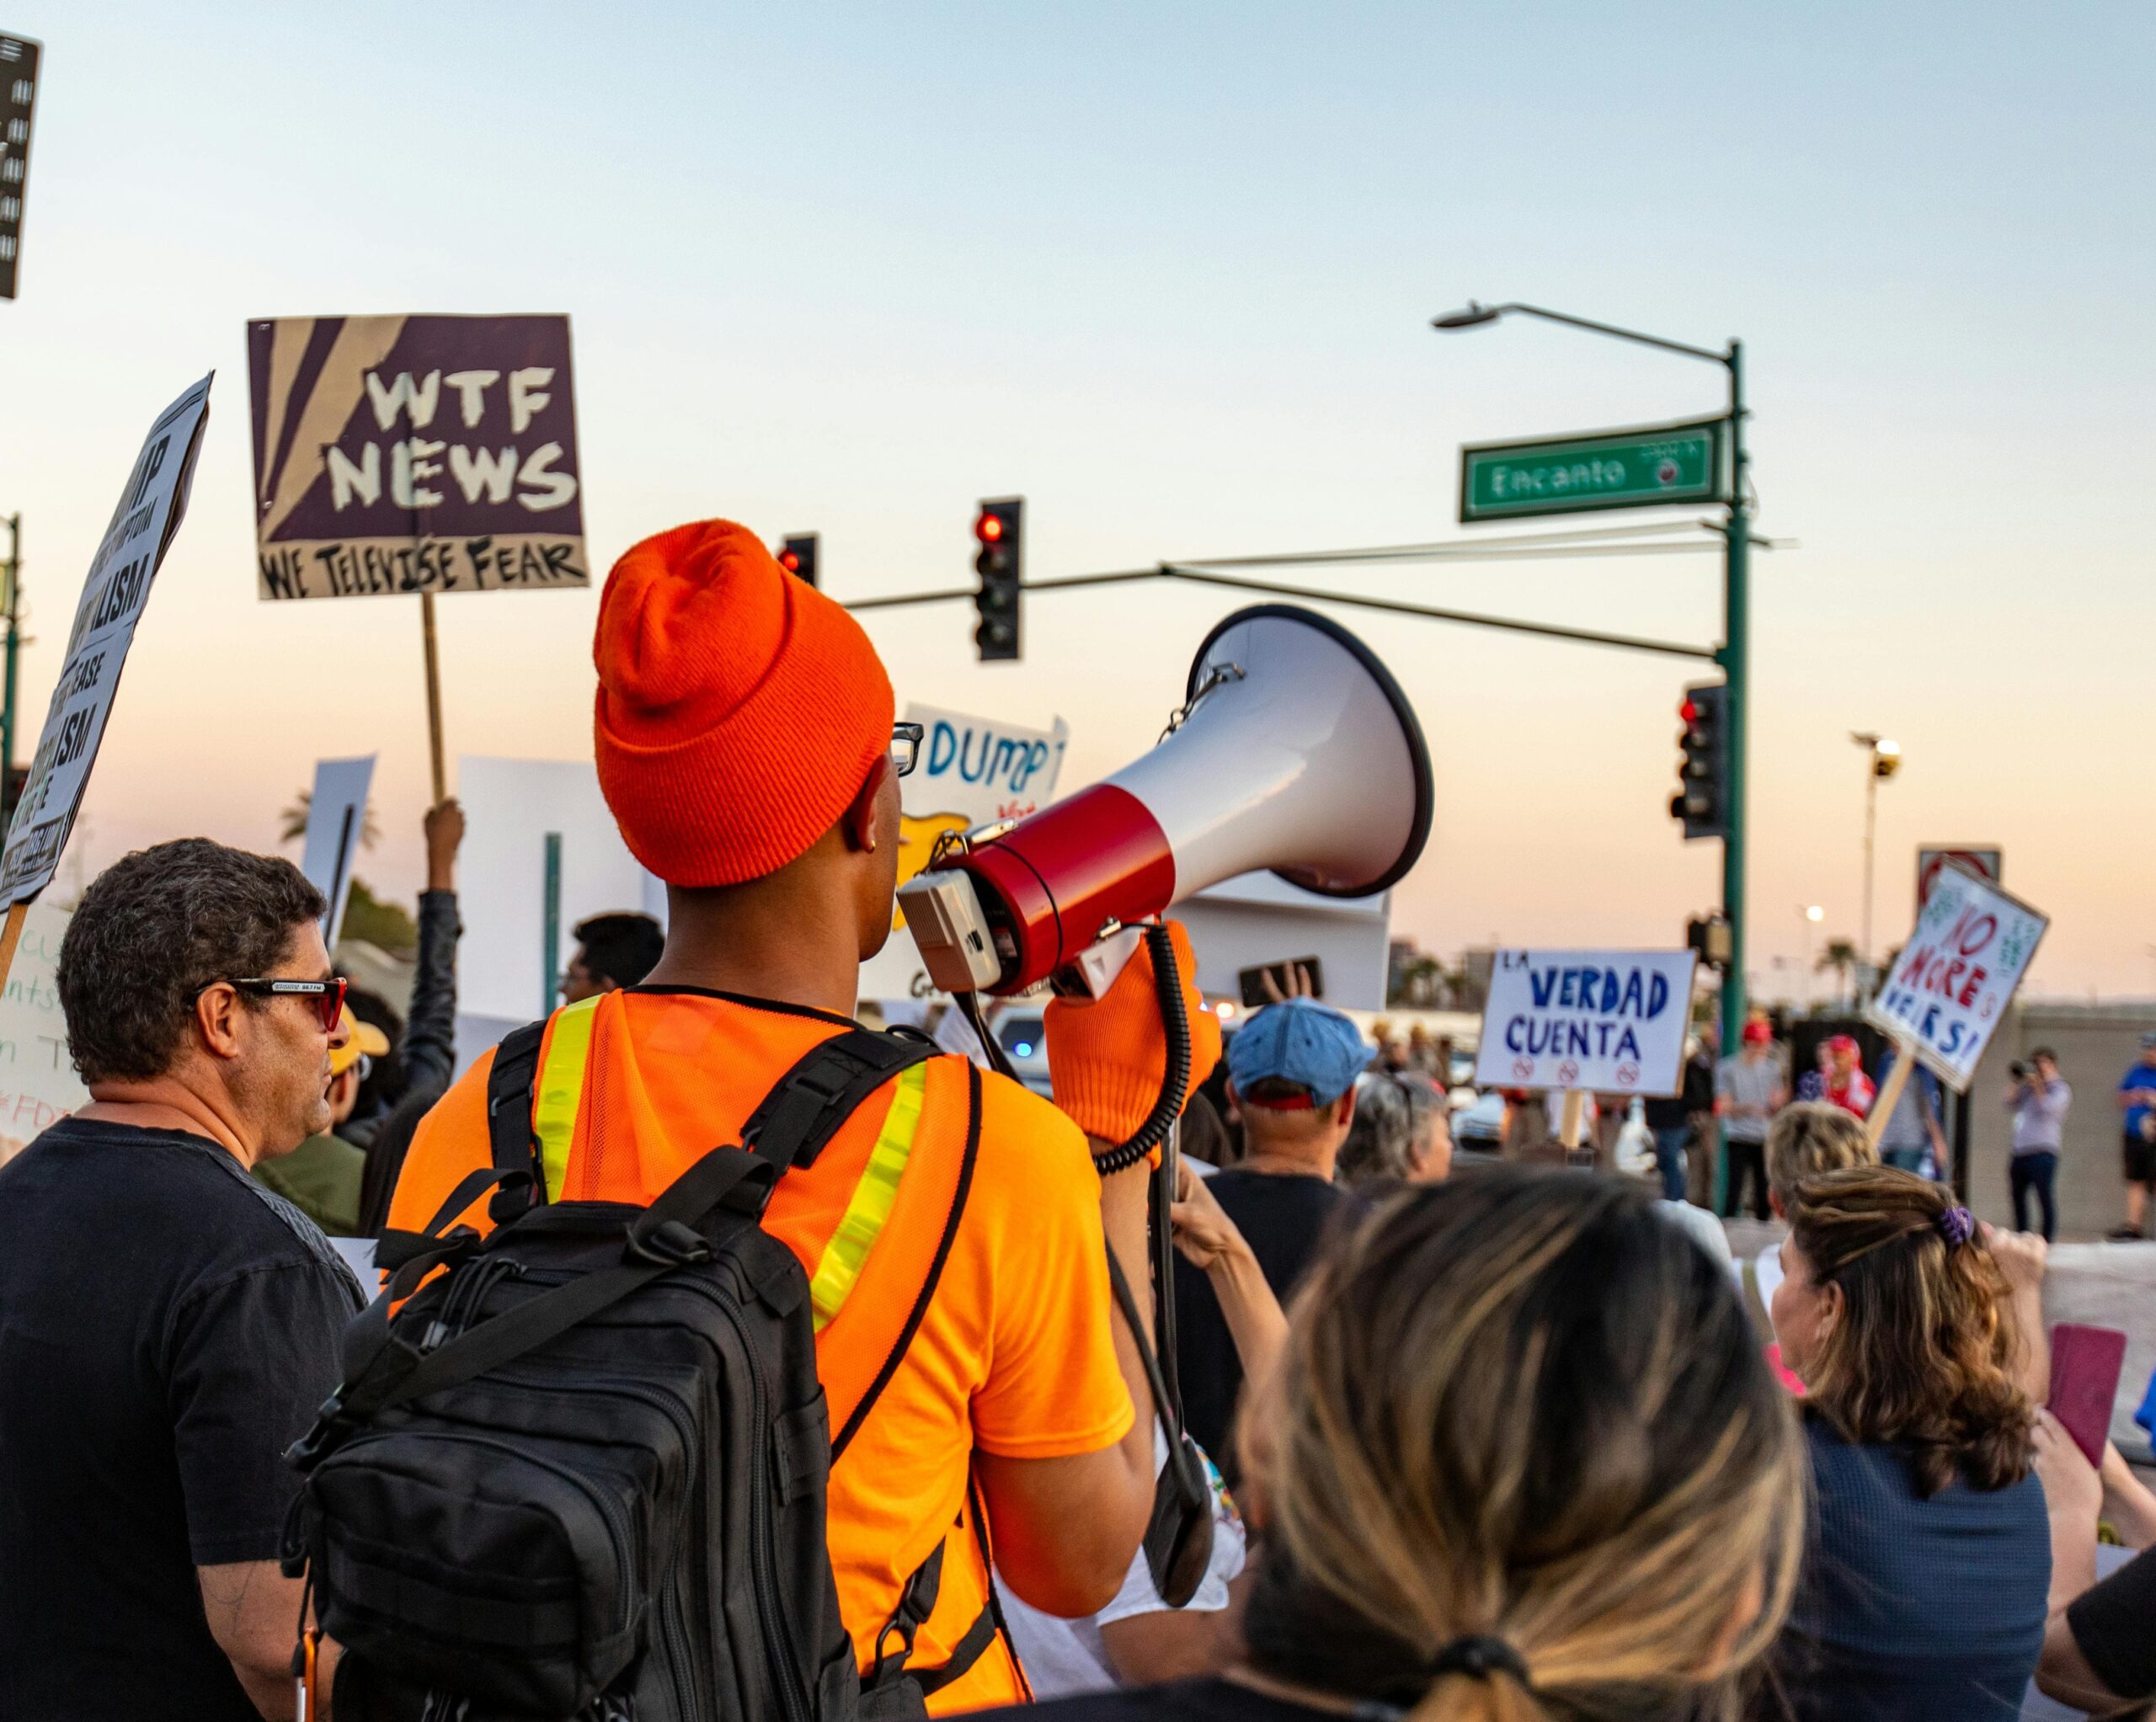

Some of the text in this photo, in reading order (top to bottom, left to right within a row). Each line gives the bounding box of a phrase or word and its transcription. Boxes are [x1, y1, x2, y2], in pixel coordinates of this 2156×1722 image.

[366, 366, 556, 434] WTF
[327, 436, 578, 512] NEWS
[1491, 457, 1626, 498] Encanto
[259, 536, 588, 599] WE TELEVISE FEAR
[1940, 902, 1998, 957] NO
[1502, 951, 1669, 1020] LA VERDAD
[1899, 945, 1988, 1009] MORE
[1505, 1014, 1641, 1060] CUENTA
